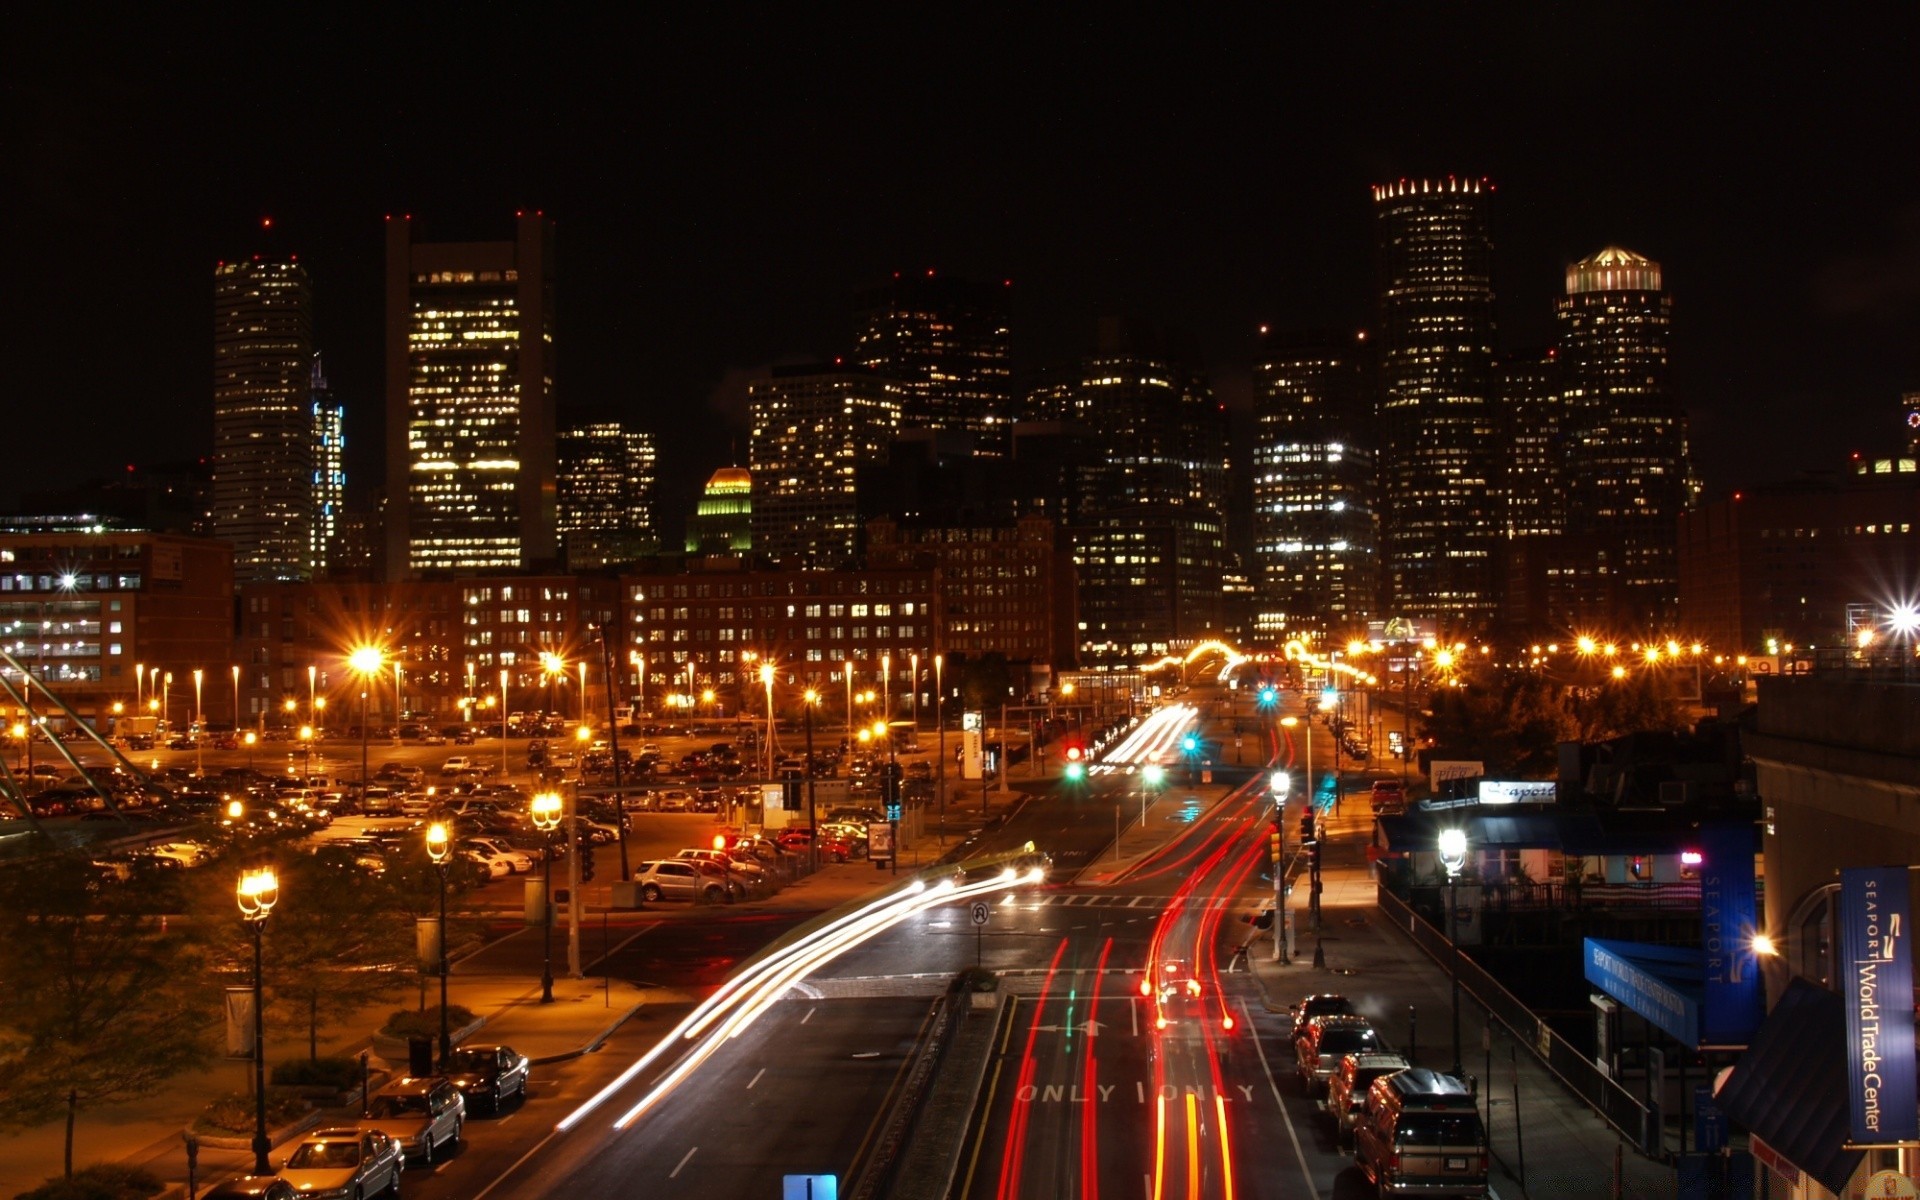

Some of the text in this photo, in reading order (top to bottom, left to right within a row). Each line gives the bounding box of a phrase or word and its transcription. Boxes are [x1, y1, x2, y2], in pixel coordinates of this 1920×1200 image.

[1706, 876, 1723, 983] SEAPORT
[1859, 880, 1882, 1133] SEAPORT World Trade Center
[1016, 1083, 1255, 1103] ONLY ONLY
